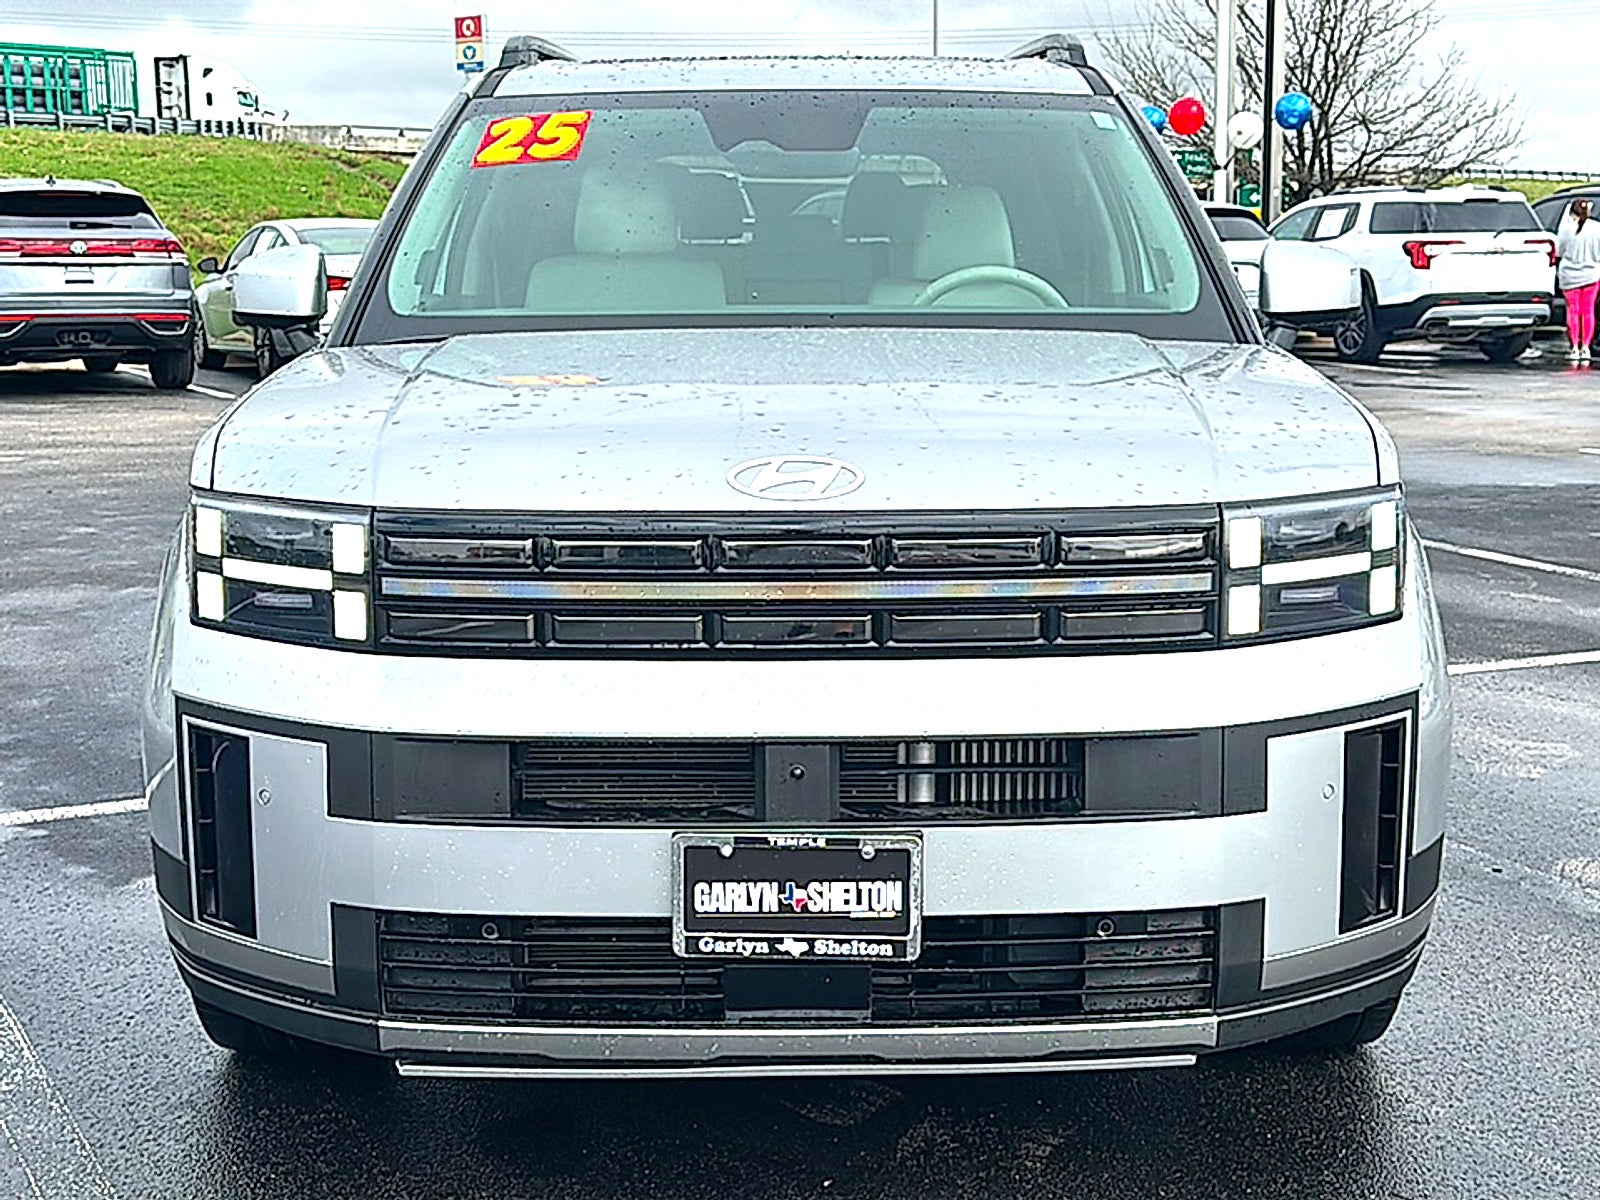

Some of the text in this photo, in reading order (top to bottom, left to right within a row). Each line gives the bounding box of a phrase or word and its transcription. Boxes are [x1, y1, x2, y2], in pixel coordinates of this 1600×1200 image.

[476, 111, 589, 164] 25
[768, 837, 827, 848] TEMPLE
[694, 881, 903, 912] GARLYN SHELTON
[698, 937, 893, 956] Garlyn Shelton
